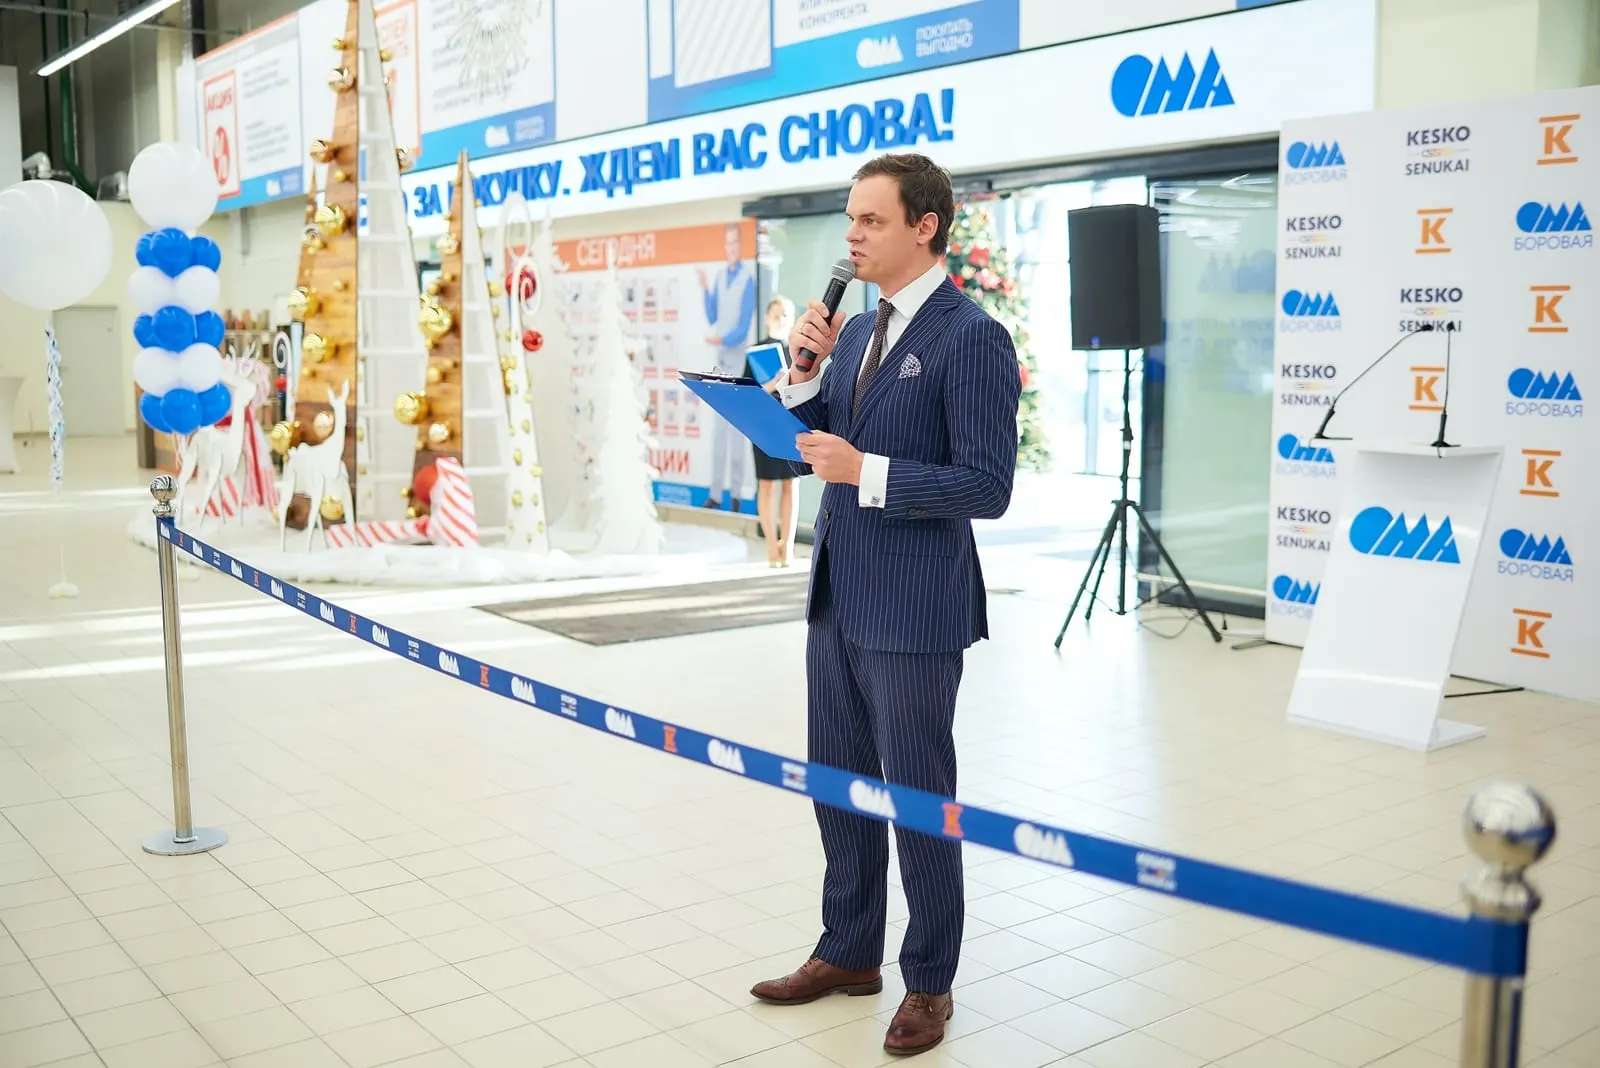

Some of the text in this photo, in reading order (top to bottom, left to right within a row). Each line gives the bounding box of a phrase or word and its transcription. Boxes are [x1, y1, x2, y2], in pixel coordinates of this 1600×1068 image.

[1407, 126, 1471, 146] KESKO
[414, 184, 442, 217] ЗА
[448, 160, 571, 212] КУПКУ.
[580, 138, 681, 198] ЖДЕМ
[693, 123, 767, 175] ВАС
[779, 88, 955, 164] СНОВА!
[1405, 158, 1470, 176] SENUKAI
[1287, 215, 1342, 232] KESKO
[1514, 234, 1593, 251] БОРОВАЯ
[1285, 246, 1341, 260] SENUKAI
[1400, 288, 1463, 303] KESKO
[1399, 320, 1462, 333] SENUKI
[1281, 364, 1336, 379] KESKO
[1506, 401, 1584, 418] БОРОВАЯ
[1277, 506, 1331, 524] KESKO
[1276, 534, 1330, 552] SENUKAI
[1498, 560, 1573, 582] БОРОВАЯ
